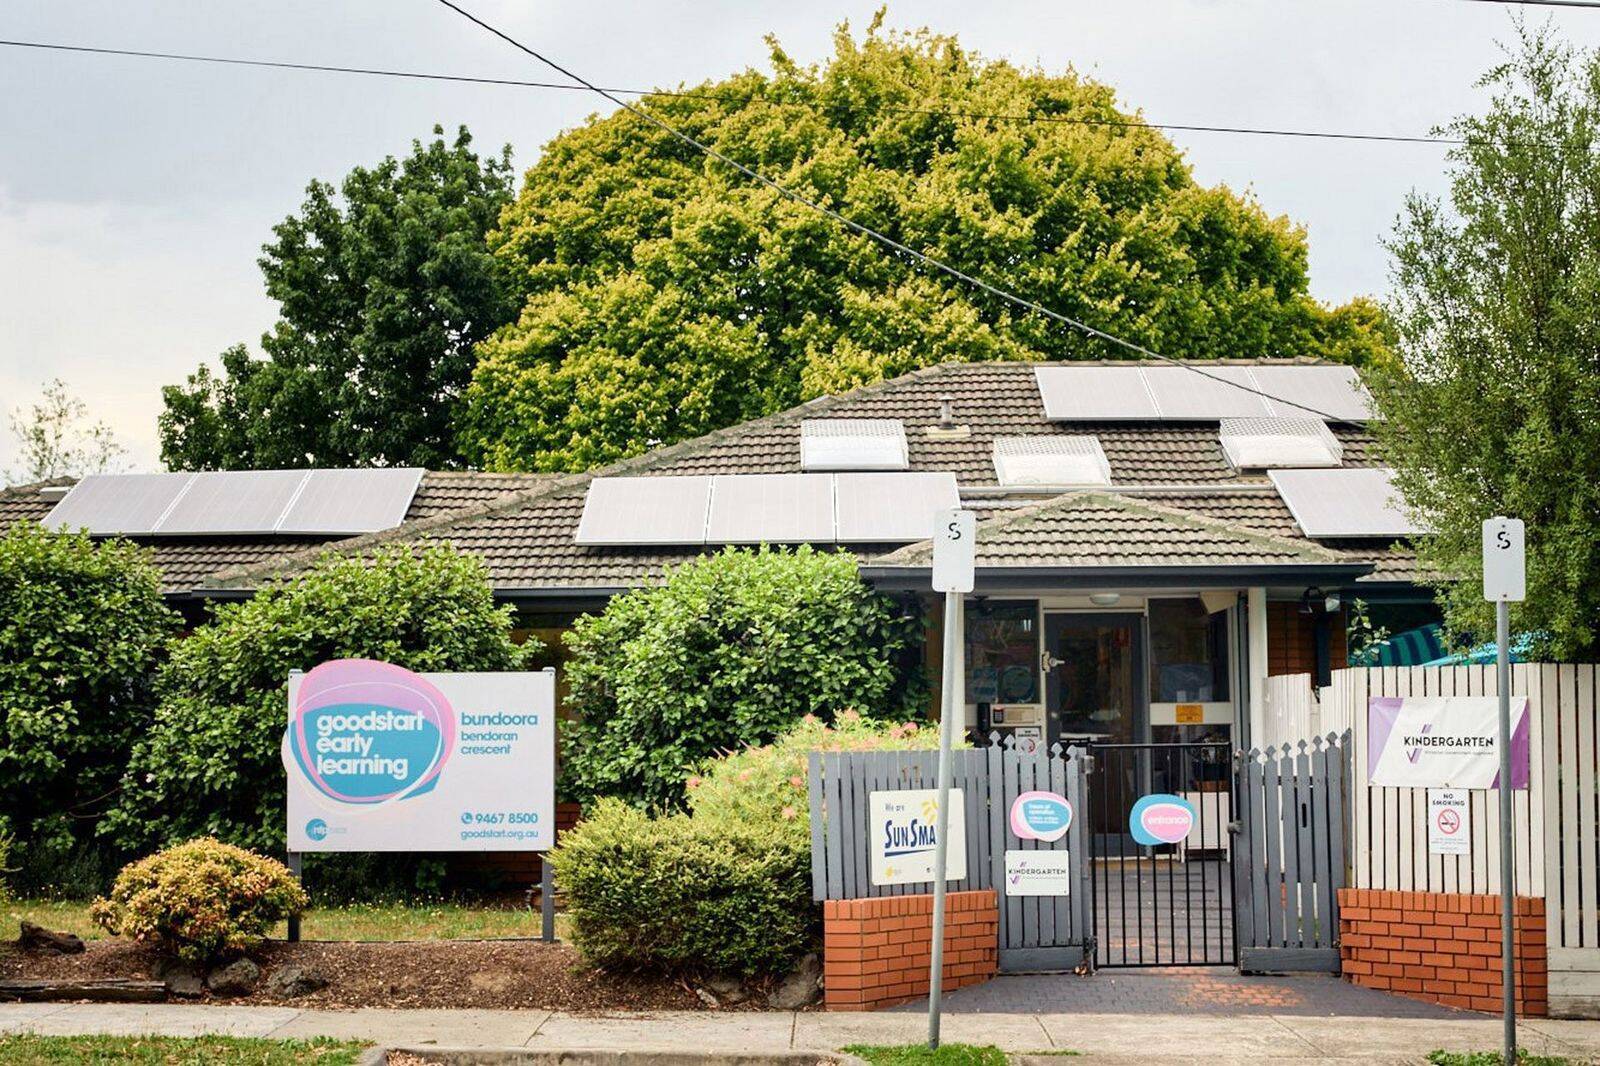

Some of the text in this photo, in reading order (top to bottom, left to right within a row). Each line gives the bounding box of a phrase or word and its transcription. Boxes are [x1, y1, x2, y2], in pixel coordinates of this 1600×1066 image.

[317, 710, 425, 736] goodstart
[461, 712, 538, 726] bundoora
[461, 731, 518, 741] bendoran
[1404, 736, 1493, 747] KINDERGARTEN
[316, 733, 374, 757] early
[460, 744, 511, 754] crescent
[317, 754, 408, 780] learning
[475, 813, 538, 824] 9467 8500
[1148, 815, 1189, 825] entrance
[460, 829, 539, 841] goodstart.org.au
